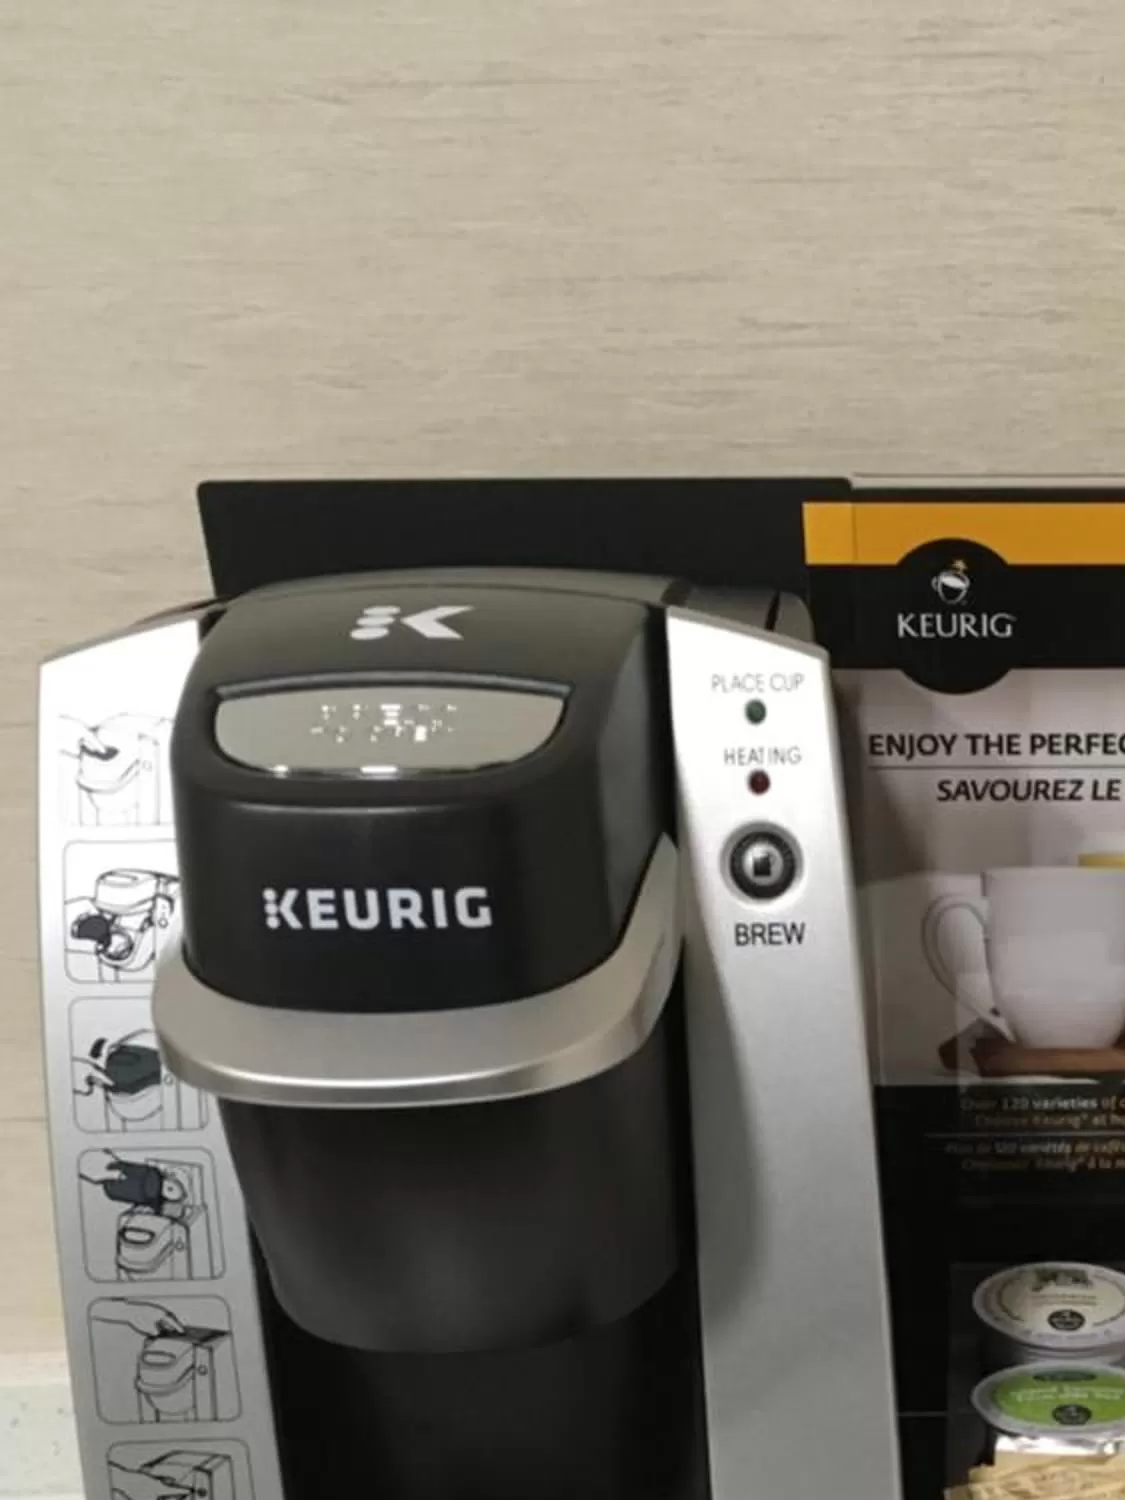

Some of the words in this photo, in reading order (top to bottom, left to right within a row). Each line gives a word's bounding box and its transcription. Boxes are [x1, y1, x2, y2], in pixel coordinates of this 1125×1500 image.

[897, 611, 1017, 639] KEURIG
[711, 672, 766, 694] PLACE
[768, 672, 805, 692] CUP
[723, 745, 803, 767] HEATING
[867, 732, 957, 761] ENJOY
[965, 732, 1022, 756] THE
[936, 778, 1083, 802] SAVOUREZ
[1090, 778, 1121, 801] LE
[262, 885, 493, 931] KEURIG
[734, 922, 806, 947] BREW
